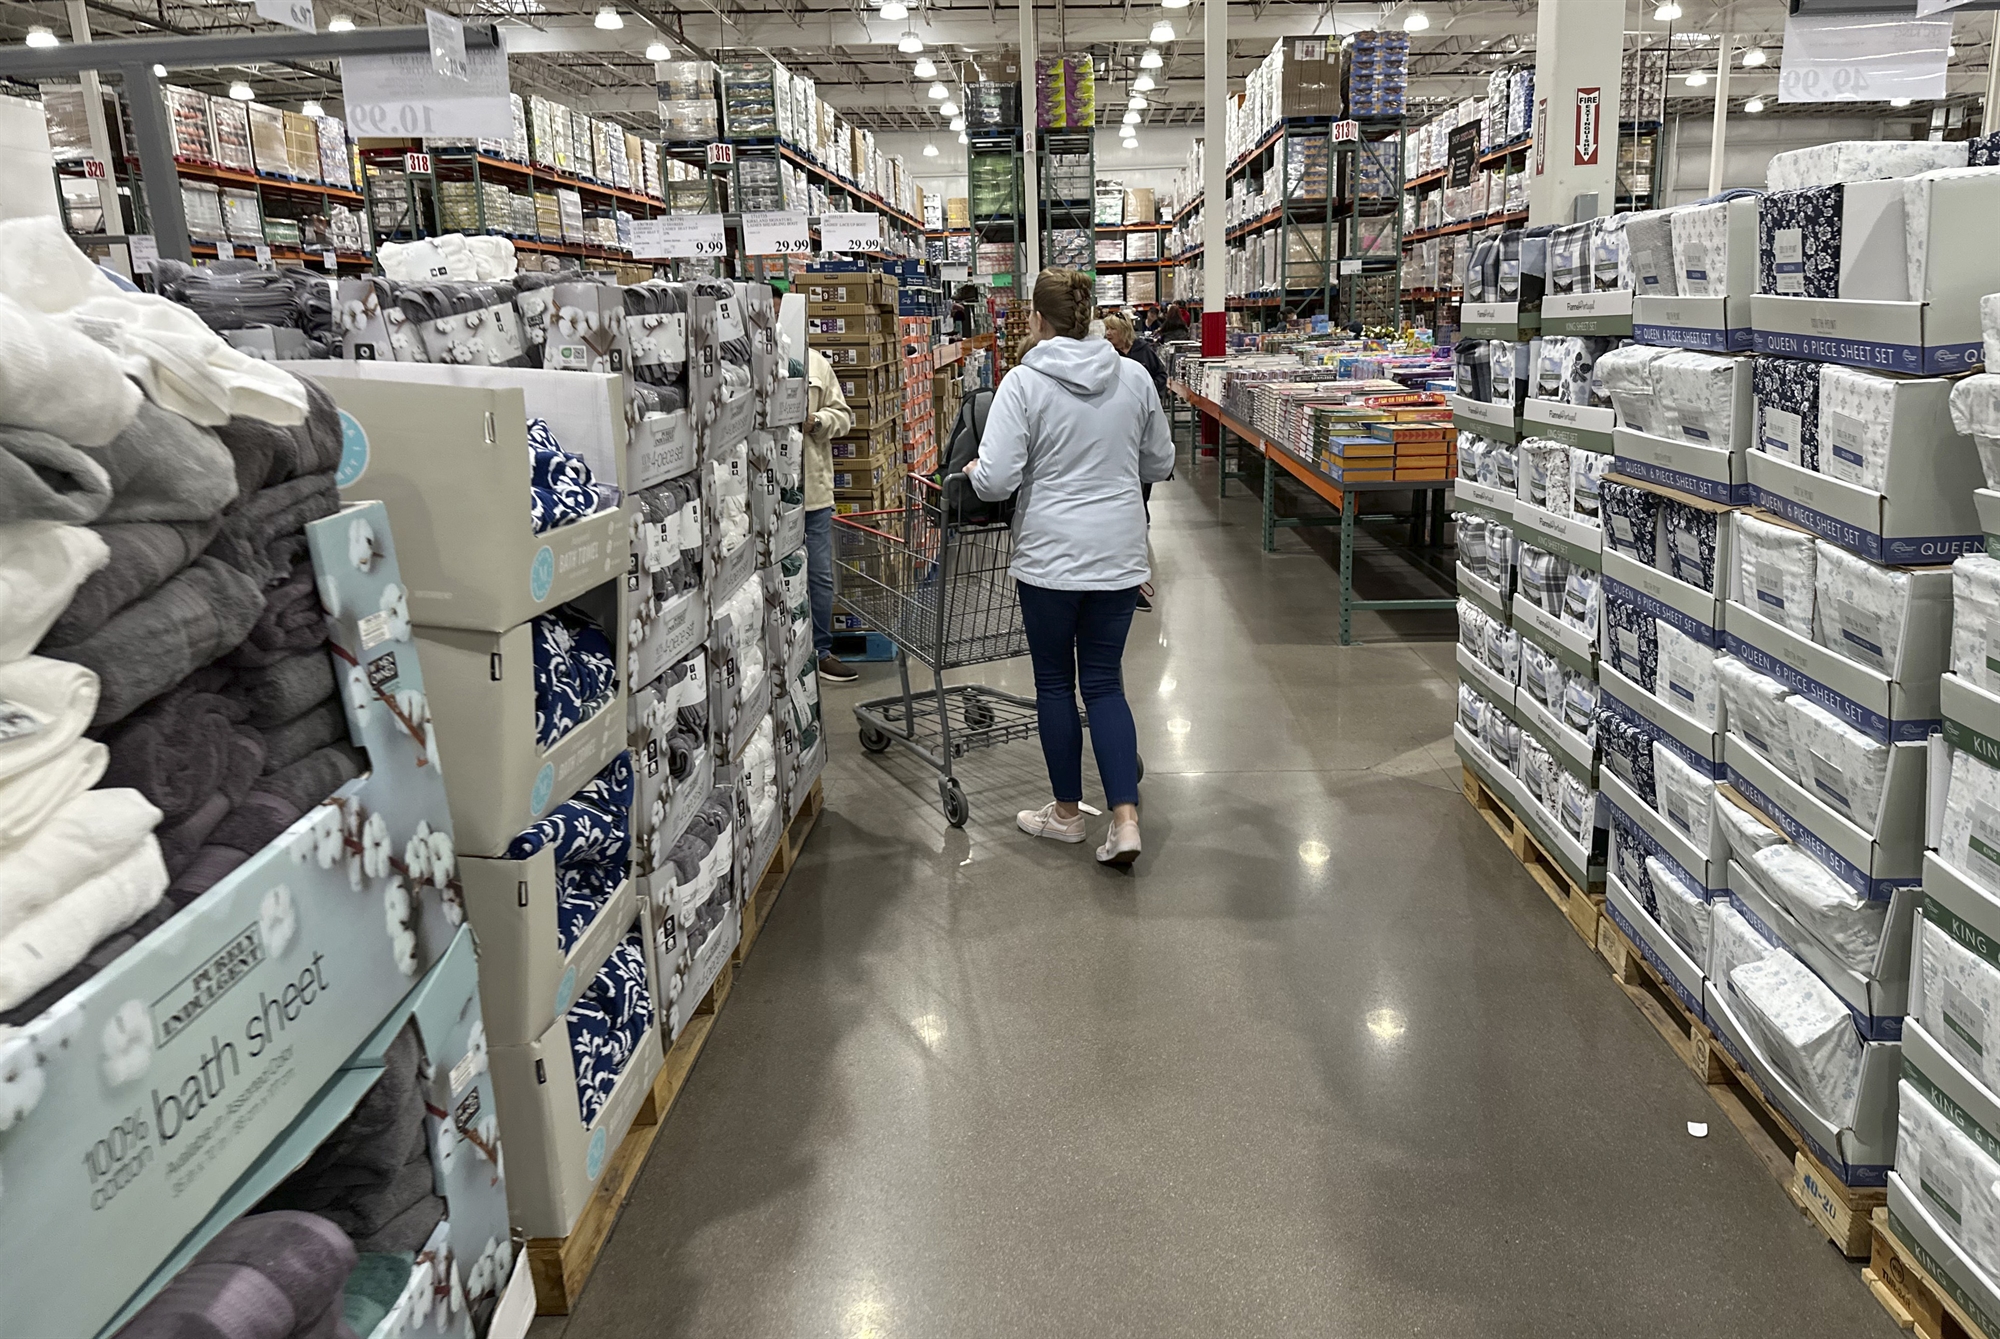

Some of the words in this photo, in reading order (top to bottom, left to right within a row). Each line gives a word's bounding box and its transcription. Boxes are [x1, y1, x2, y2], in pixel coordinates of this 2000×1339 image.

[1335, 121, 1350, 140] 313
[1583, 105, 1591, 156] EXTINGUISHER
[86, 161, 106, 178] 320
[410, 155, 429, 172] 318
[715, 145, 731, 162] 316
[696, 241, 723, 254] 9.99
[775, 239, 809, 252] 29.99
[848, 239, 879, 250] 29.99
[823, 292, 829, 300] 9
[1643, 328, 1660, 339] QUEEN
[1662, 331, 1666, 341] 6
[1667, 330, 1682, 342] PIECE
[1682, 331, 1701, 344] SHEET
[1701, 333, 1711, 345] SET
[1767, 335, 1797, 352] QUEEN
[1803, 340, 1808, 353] 6
[1811, 340, 1838, 357] PIECE
[1840, 343, 1871, 361] SHEET
[1875, 347, 1894, 364] SET
[1625, 461, 1646, 476] QUEEN
[1649, 468, 1654, 479] 6
[1655, 469, 1674, 485] PIECE
[1675, 475, 1697, 491] SHEET
[1699, 481, 1712, 495] SET
[1759, 492, 1783, 513] QUEEN
[1787, 505, 1793, 517] 6
[1794, 506, 1814, 527] PIECE
[1816, 516, 1842, 539] SHEET
[1844, 528, 1860, 546] SET
[1920, 541, 1986, 555] QUEEN
[1612, 583, 1634, 600] QUEEN
[1637, 594, 1641, 604] 6
[1643, 597, 1660, 615] PIECE
[1662, 606, 1682, 626] SHEET
[1684, 618, 1697, 633] SET
[1741, 645, 1770, 669] QUEEN
[1775, 663, 1781, 676] 6
[1783, 667, 1808, 692] PIECE
[1811, 683, 1841, 710] SHEET
[1845, 701, 1863, 723] SET
[1660, 731, 1681, 751] SHEET
[1682, 746, 1696, 764] SET
[1974, 736, 2000, 761] KIN
[1738, 779, 1765, 807] QUEEN
[1768, 804, 1774, 815] 6
[1775, 807, 1797, 836] PIECE
[1800, 828, 1827, 859] SHEET
[1829, 852, 1847, 875] SET
[1609, 803, 1631, 827] QUEEN
[1633, 825, 1638, 834] 6
[1639, 829, 1656, 852] PIECE
[1657, 847, 1678, 872] SHEET
[1678, 867, 1691, 885] SET
[1742, 907, 1768, 936] QUEEN
[1952, 917, 1987, 954] KING
[1614, 911, 1634, 938] QUEEN
[1636, 935, 1640, 946] 6
[1640, 942, 1656, 965] PIECE
[1658, 960, 1676, 982] SHEET
[1676, 980, 1688, 1000] SET
[151, 1034, 240, 1147] bath
[245, 950, 330, 1058] sheet
[1930, 1086, 1966, 1128] KING
[1974, 1127, 1982, 1142] 6
[82, 1106, 150, 1184] 100%
[90, 1144, 155, 1210] cotton
[1914, 1244, 1947, 1286] KING
[1956, 1289, 1964, 1304] 6
